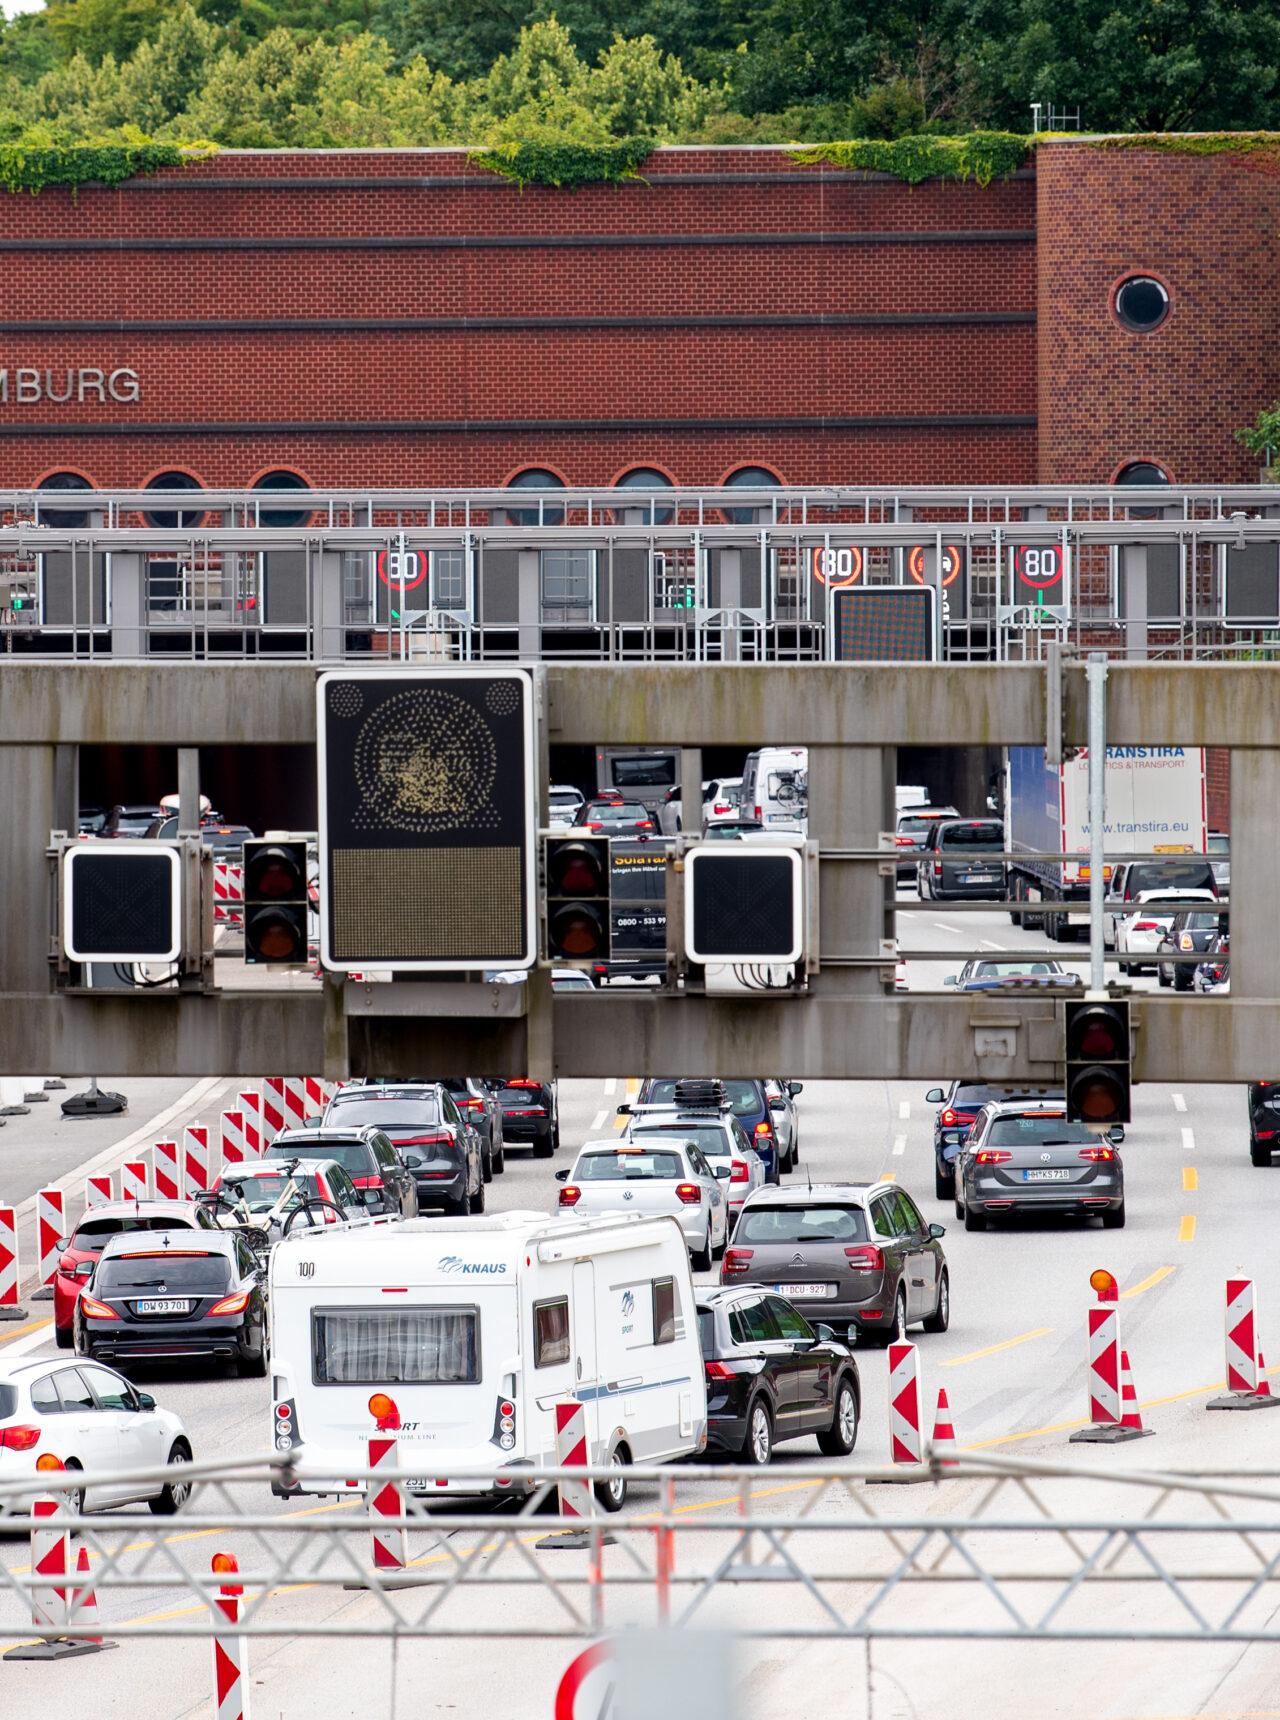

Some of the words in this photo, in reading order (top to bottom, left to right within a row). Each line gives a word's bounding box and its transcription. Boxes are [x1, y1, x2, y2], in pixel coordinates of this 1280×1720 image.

[389, 552, 418, 579] 80
[822, 549, 853, 576] 80
[1024, 549, 1056, 576] 80
[1078, 761, 1124, 771] LOTICS
[1134, 759, 1185, 770] TRANSPORT
[1081, 819, 1189, 834] ww.transtira.eu
[617, 918, 637, 926] 0800
[298, 1262, 315, 1278] 100
[462, 1263, 507, 1274] KNAUS
[143, 1302, 156, 1311] DW
[157, 1302, 169, 1310] 93
[170, 1301, 187, 1310] 701
